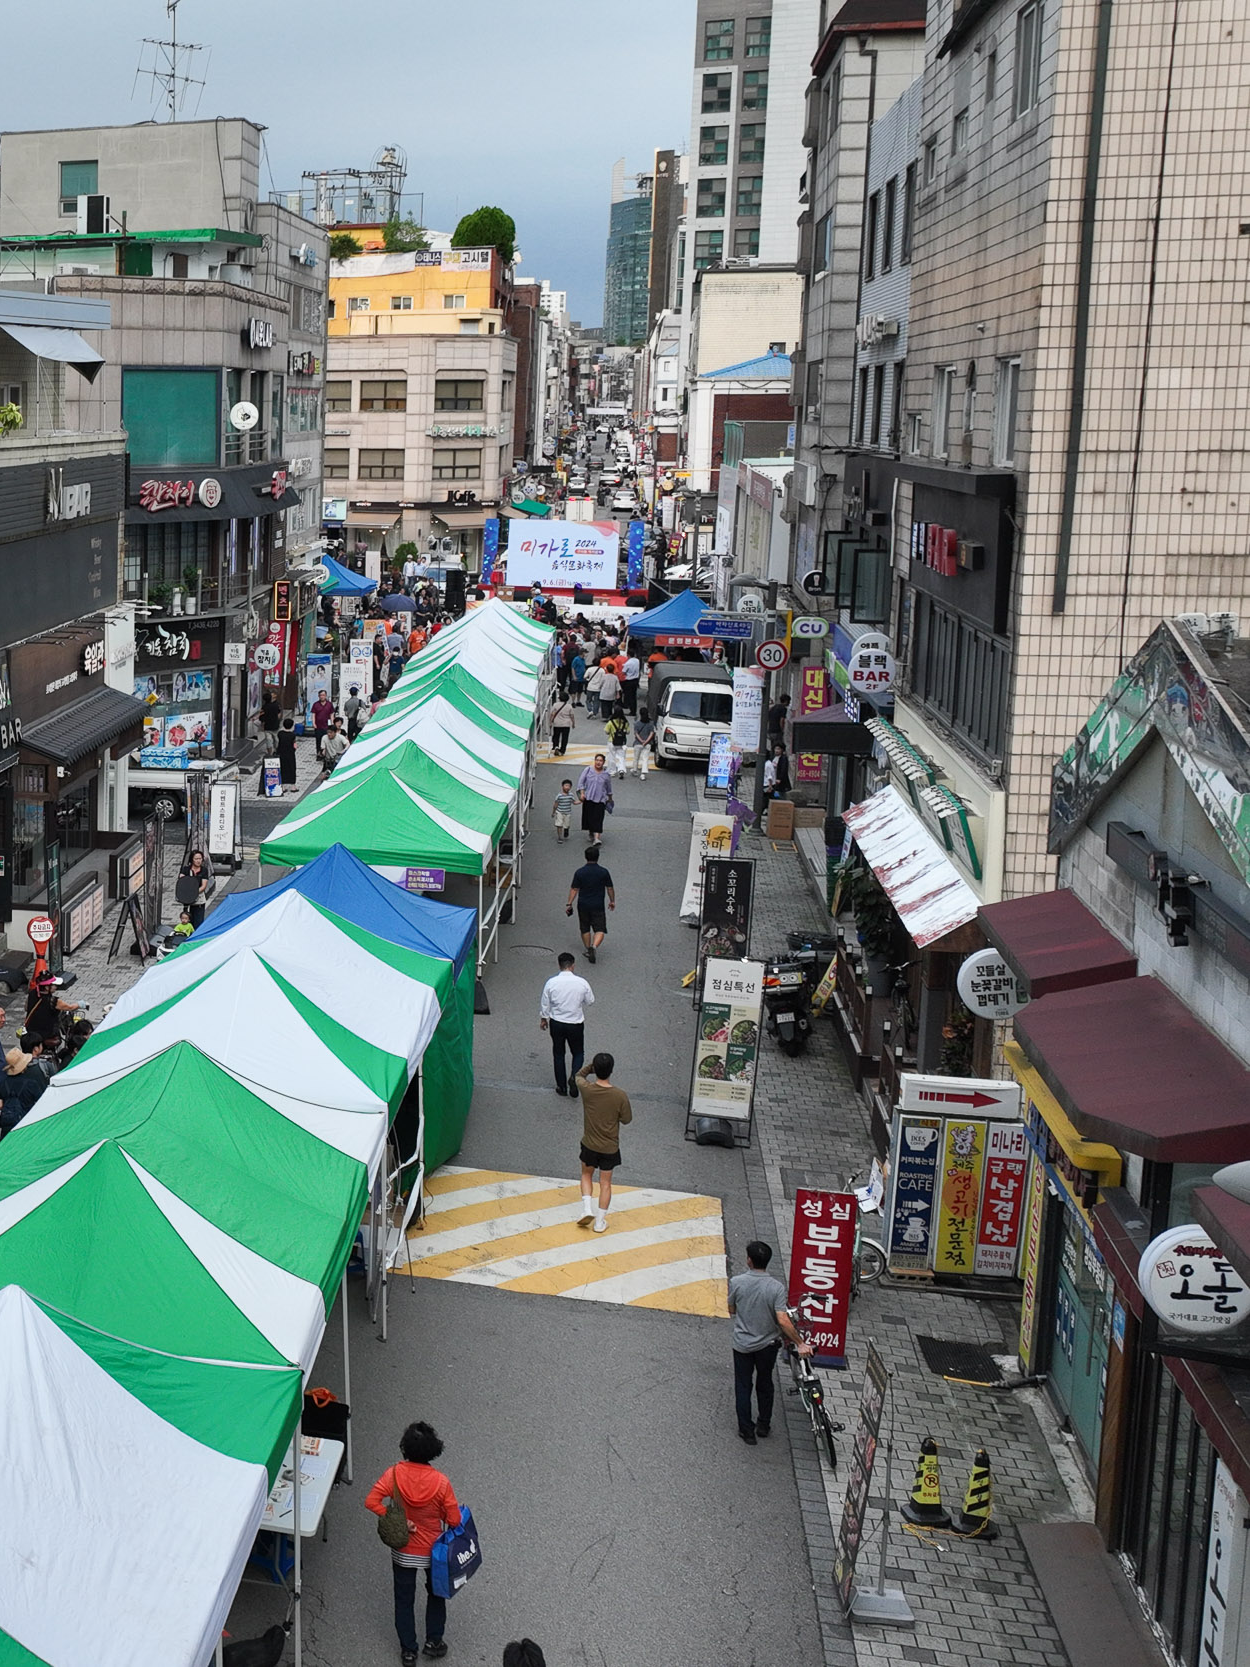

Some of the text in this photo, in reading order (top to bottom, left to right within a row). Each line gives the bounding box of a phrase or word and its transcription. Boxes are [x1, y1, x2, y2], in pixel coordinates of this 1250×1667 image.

[521, 538, 597, 558] 미가로 2024
[552, 560, 604, 571] 음식문화축제
[800, 623, 822, 634] CU
[158, 625, 190, 660] 참치
[258, 655, 270, 664] 참치
[763, 649, 782, 662] 30
[858, 655, 887, 669] 블랙
[853, 671, 890, 682] BAR
[1, 718, 22, 749] BAR
[725, 870, 738, 915] 소꼬리수육
[976, 964, 1006, 976] 꼬들살
[712, 978, 756, 993] 점심특선
[971, 978, 1014, 993] 눈꽃갈비
[977, 992, 1010, 1006] 껍데기
[992, 1130, 1026, 1155] 미나리
[901, 1156, 935, 1166] 커피볶는집
[953, 1161, 974, 1173] 제주
[990, 1160, 1023, 1175] 급랭
[899, 1179, 932, 1191] CAFE
[951, 1175, 972, 1216] 생고기
[801, 1200, 850, 1220] 성심
[985, 1177, 1019, 1244] 삼겹살
[945, 1218, 968, 1266] 전문점
[801, 1224, 841, 1323] 부동산
[1170, 1261, 1243, 1313] 오돌
[1168, 1313, 1231, 1324] 국가대표 고기맛집
